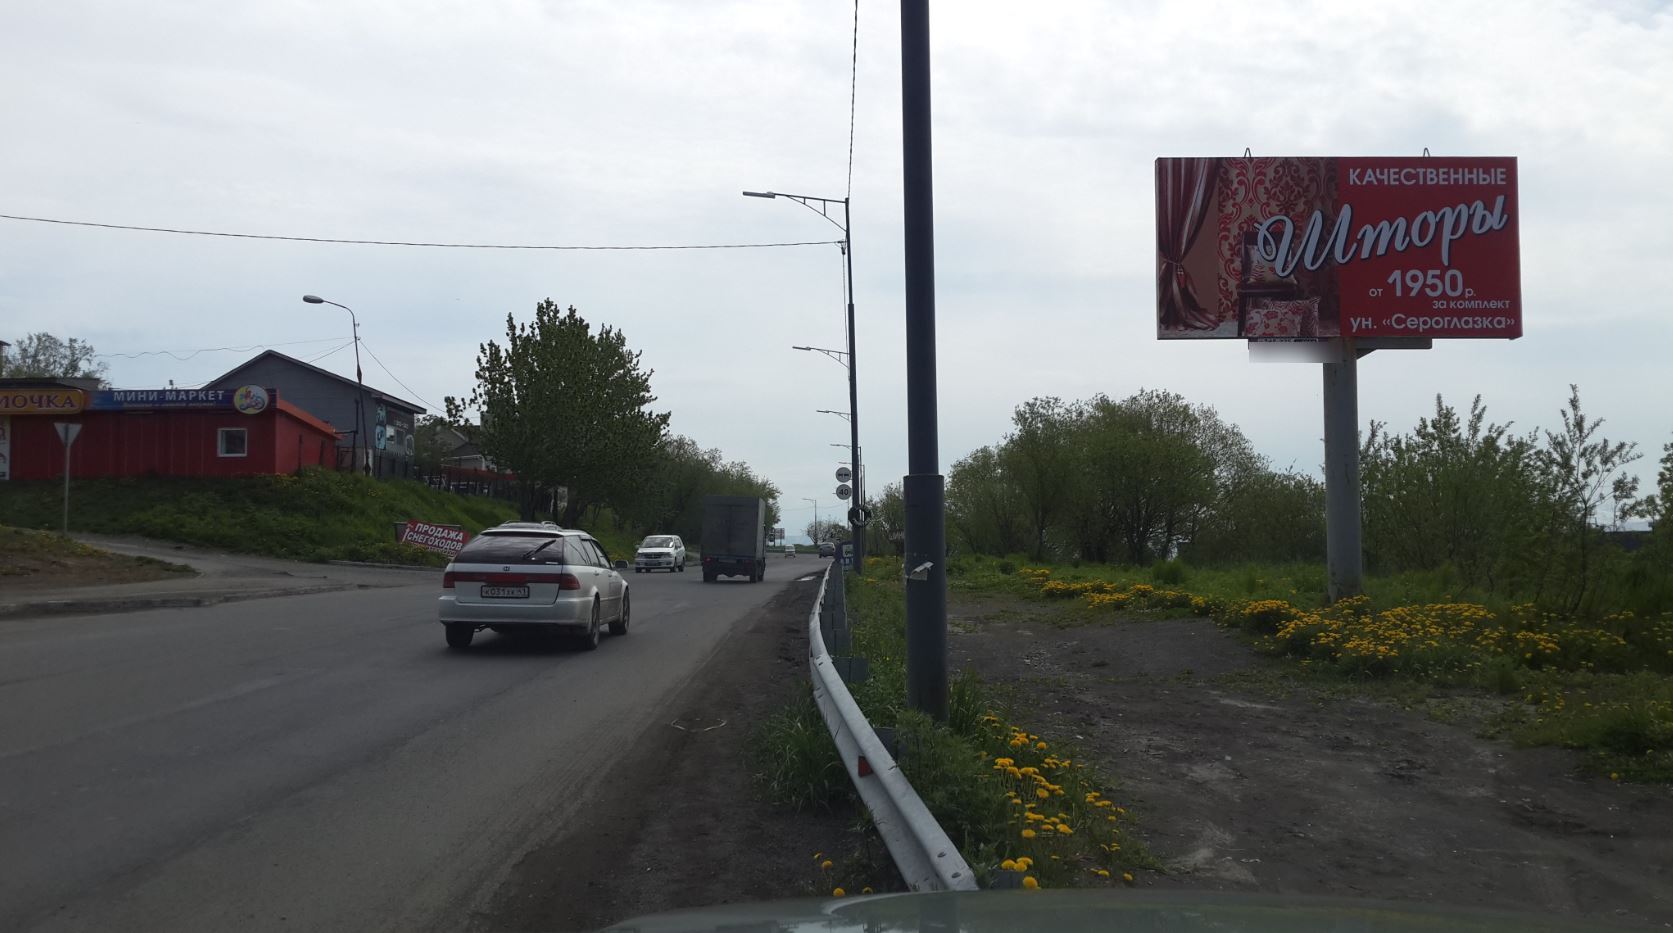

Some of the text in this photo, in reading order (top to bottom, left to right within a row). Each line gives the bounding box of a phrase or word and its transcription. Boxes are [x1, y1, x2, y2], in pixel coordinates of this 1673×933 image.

[1349, 167, 1507, 186] КАЧЕСТВЕННЫЕ
[1253, 194, 1508, 278] Шторы
[1369, 287, 1384, 297] от
[1432, 299, 1510, 309] за комплект
[1350, 313, 1515, 332] ун. «Сероглазка»
[113, 390, 225, 401] МИНИ-МАРКЕТ
[407, 531, 464, 551] СНЕГОХОДОВ
[414, 522, 464, 541] ПРОДАЖА
